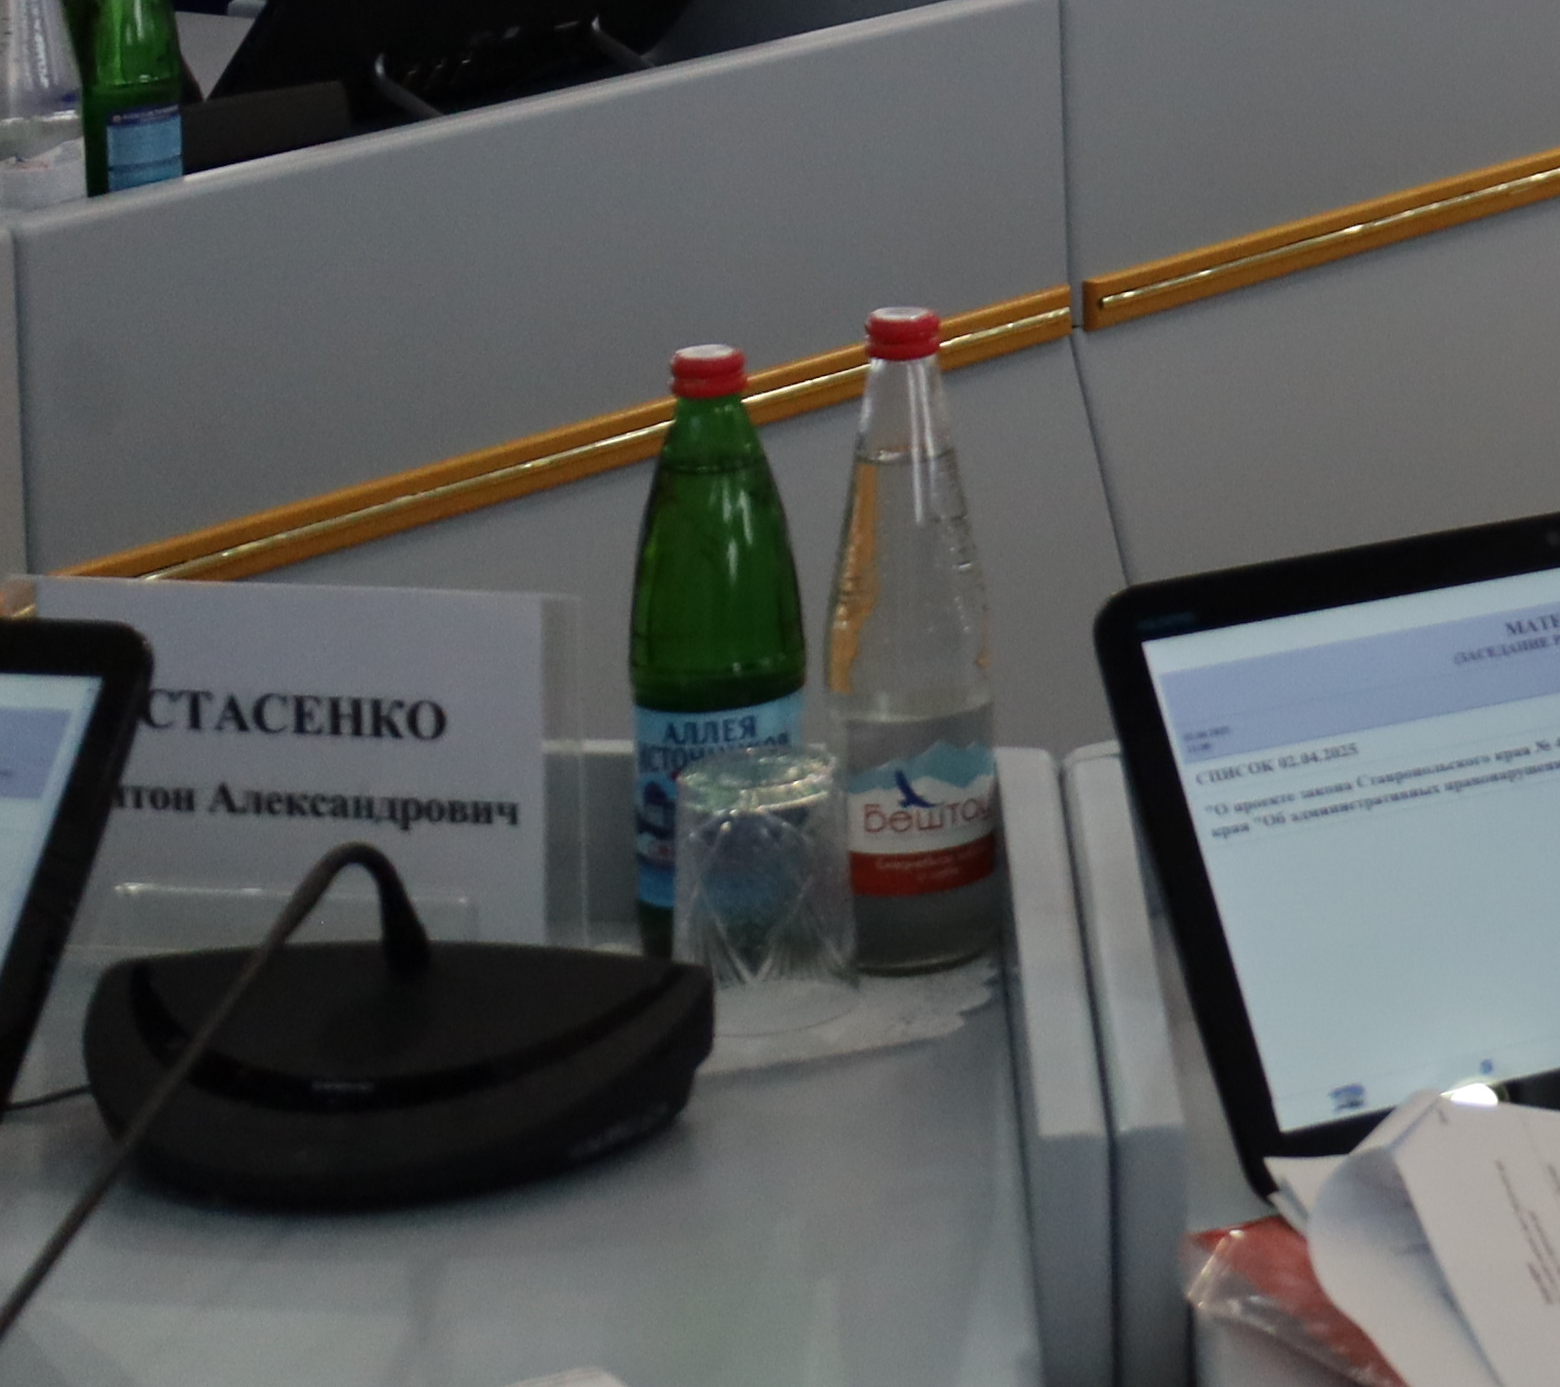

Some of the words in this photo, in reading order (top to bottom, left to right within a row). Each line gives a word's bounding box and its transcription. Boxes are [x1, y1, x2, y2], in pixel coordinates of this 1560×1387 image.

[140, 688, 448, 740] СТАСЕНКО
[662, 715, 757, 745] АЛЛЕЯ
[1195, 757, 1275, 786] СПИСОК
[1278, 742, 1359, 770] 02.04.2025
[1356, 753, 1490, 789] Ставропольского
[209, 782, 520, 831] Александрович
